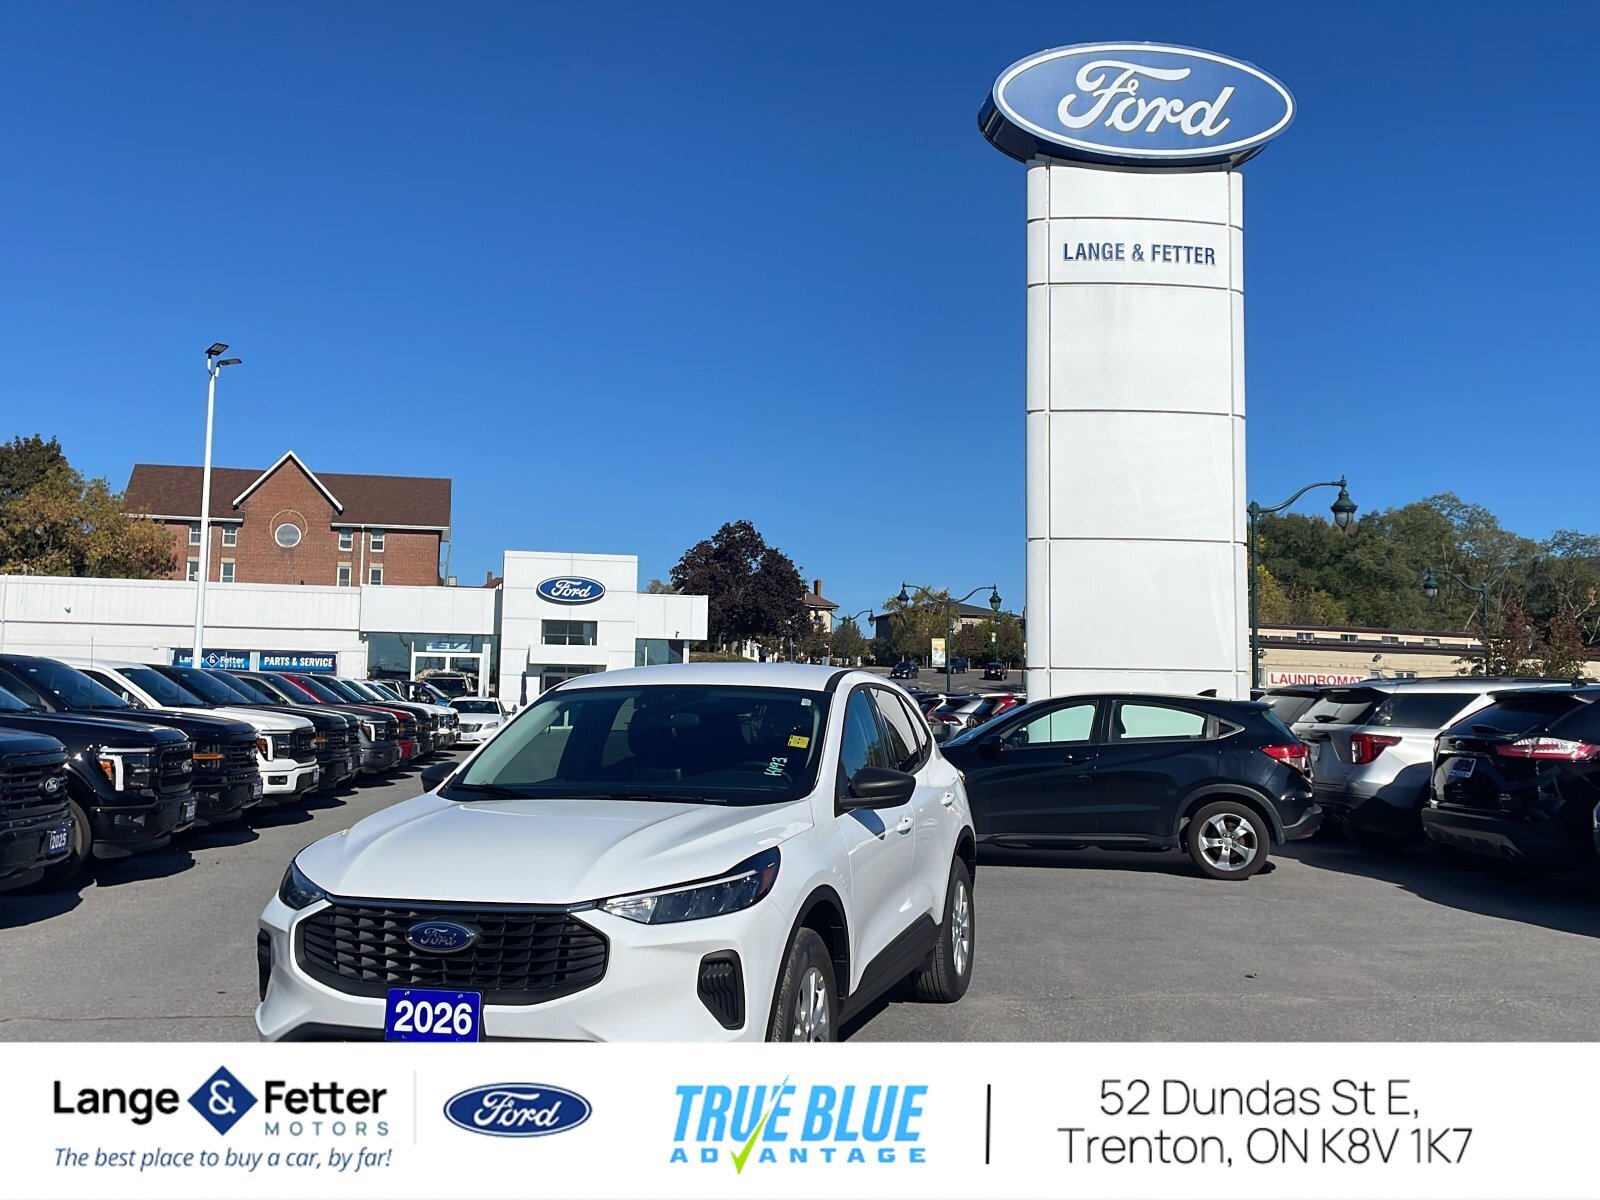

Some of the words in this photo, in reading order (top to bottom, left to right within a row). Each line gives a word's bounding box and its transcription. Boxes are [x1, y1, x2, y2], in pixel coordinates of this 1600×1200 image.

[1057, 59, 1235, 137] Ford
[1063, 242, 1125, 262] LANGE
[1131, 244, 1145, 262] &
[1151, 244, 1216, 267] FETTER
[551, 579, 592, 597] Ford
[220, 656, 245, 665] Fetter
[264, 656, 290, 667] PARTS
[292, 657, 297, 666] &
[300, 657, 333, 668] SERVICE
[1270, 673, 1363, 685] LAUNDROMAT
[420, 927, 457, 946] Ford
[393, 999, 472, 1036] 2026
